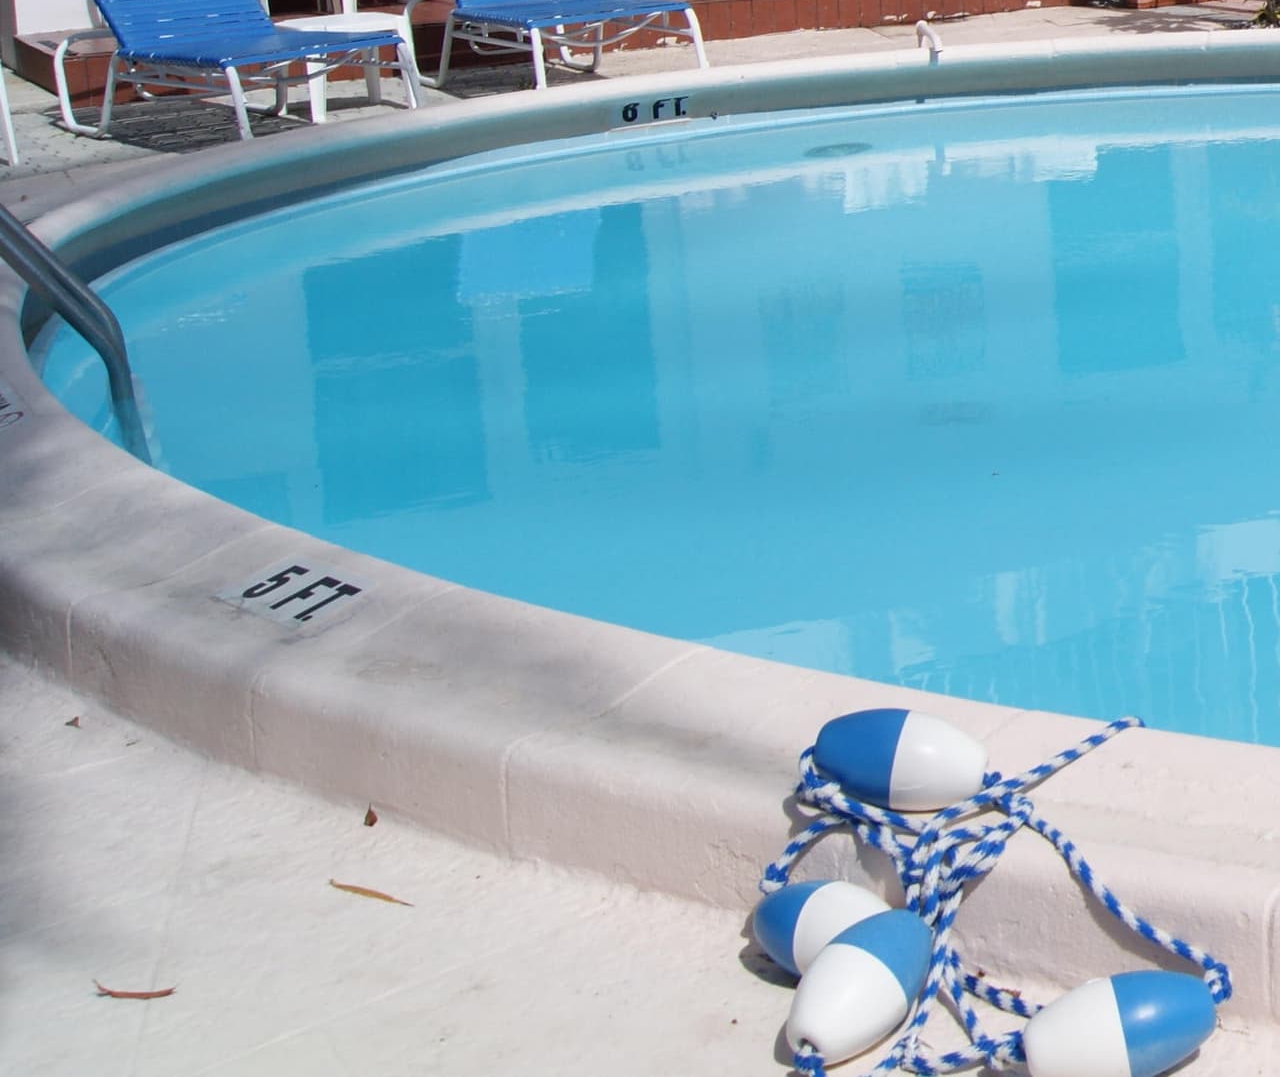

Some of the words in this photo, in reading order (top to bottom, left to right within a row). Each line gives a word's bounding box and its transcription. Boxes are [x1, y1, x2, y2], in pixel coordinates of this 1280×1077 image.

[622, 103, 640, 122] 6
[653, 96, 689, 119] FT.
[242, 565, 310, 598] 5
[269, 576, 363, 622] FT.
